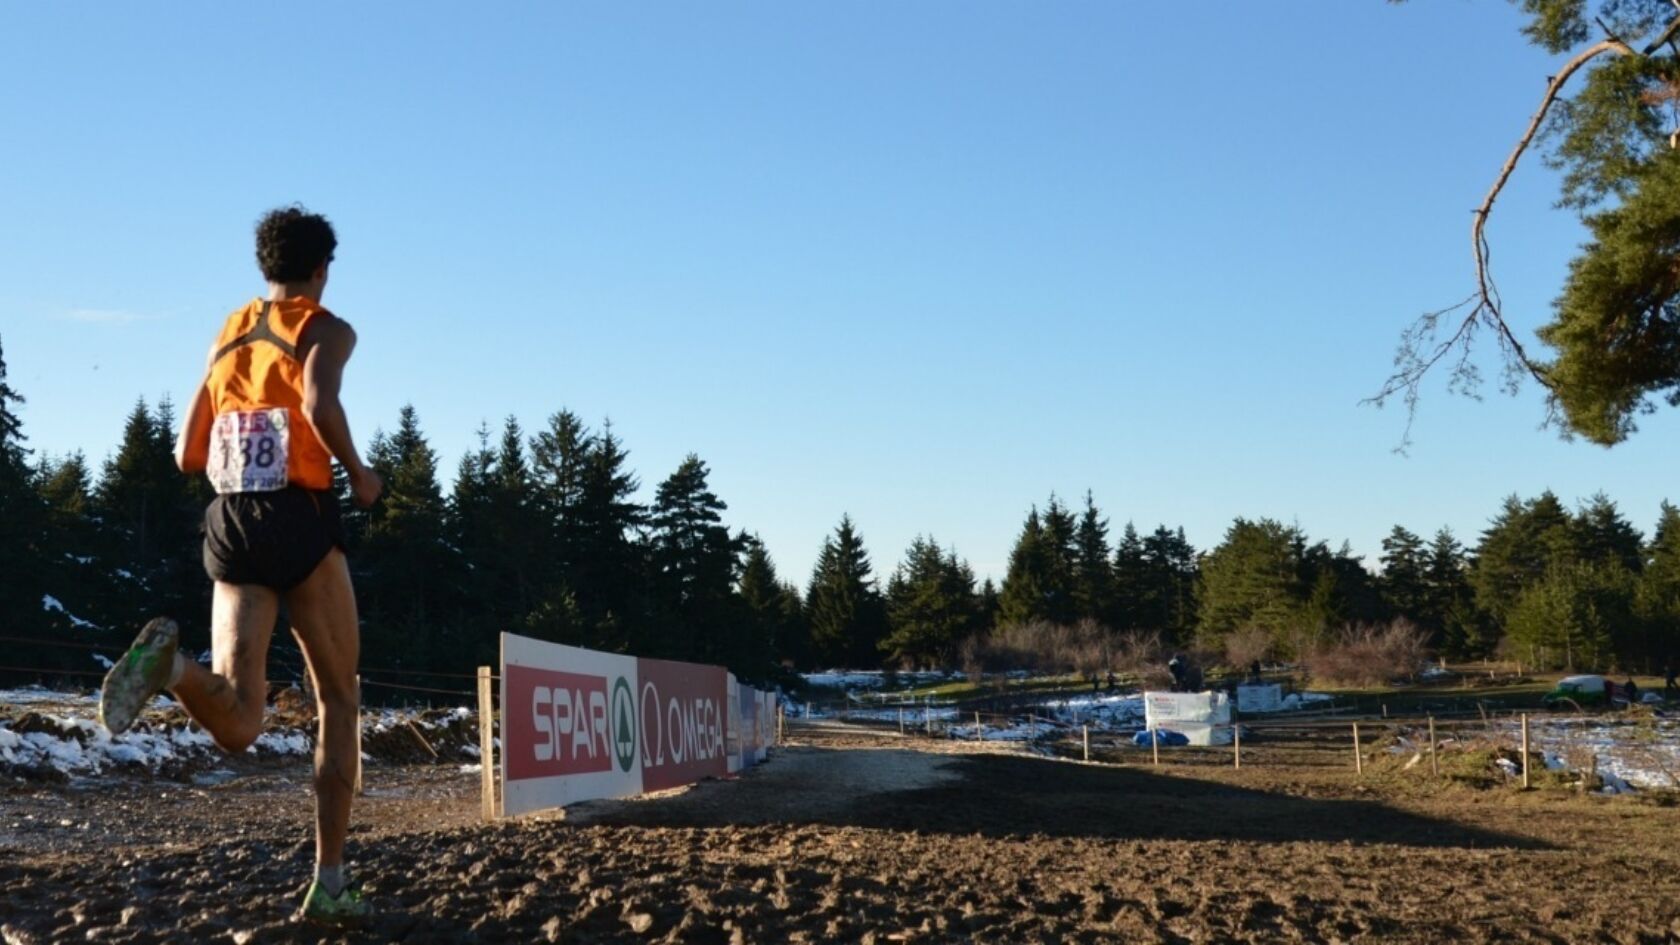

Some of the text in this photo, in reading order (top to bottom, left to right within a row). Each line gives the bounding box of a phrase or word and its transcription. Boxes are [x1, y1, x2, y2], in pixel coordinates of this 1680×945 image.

[221, 437, 275, 469] 138
[532, 685, 610, 761] SPAR
[667, 697, 725, 765] OMEGA
